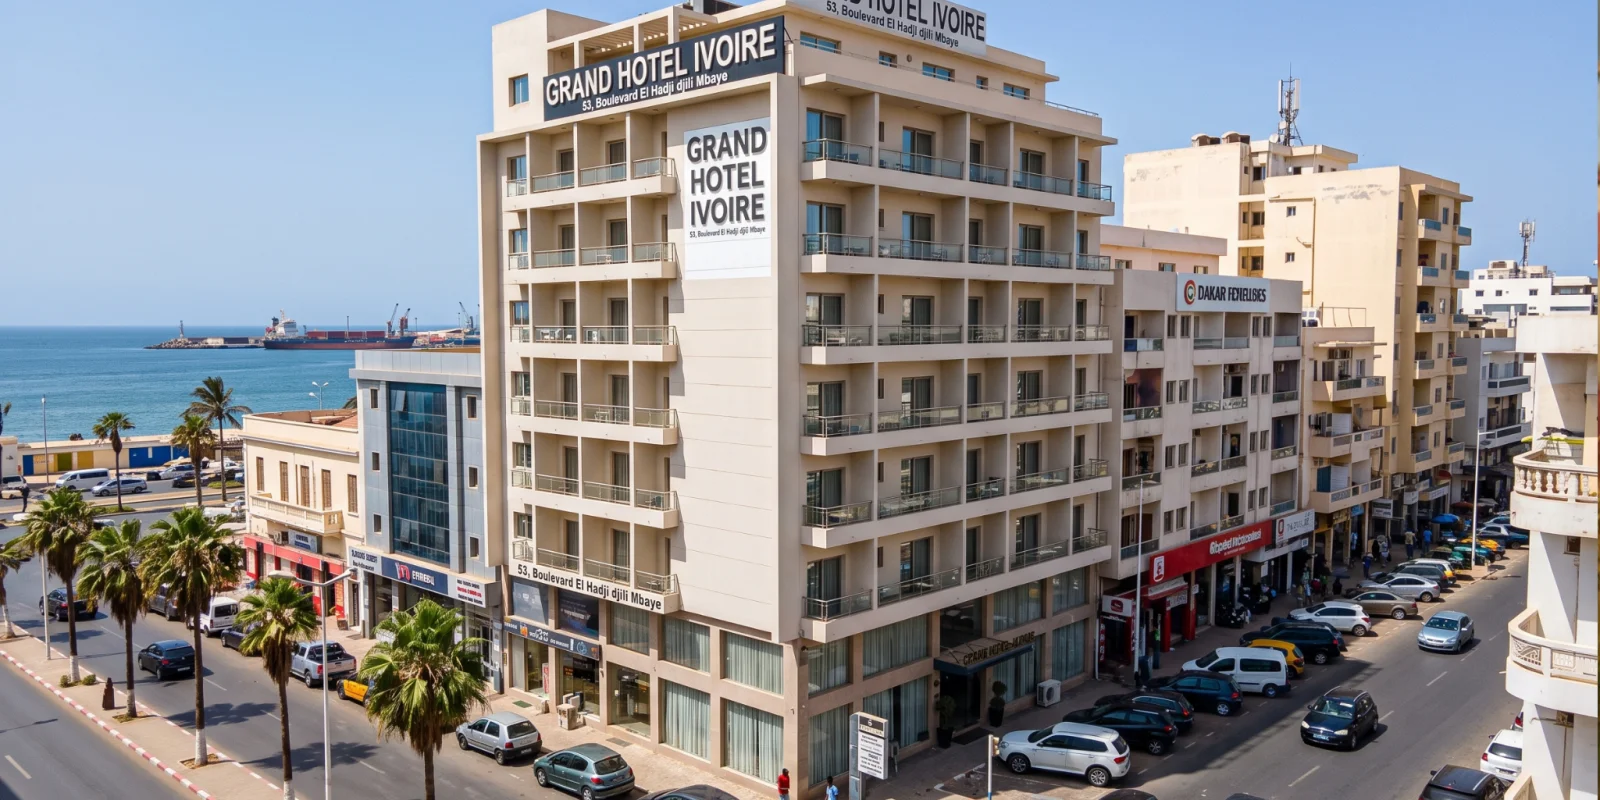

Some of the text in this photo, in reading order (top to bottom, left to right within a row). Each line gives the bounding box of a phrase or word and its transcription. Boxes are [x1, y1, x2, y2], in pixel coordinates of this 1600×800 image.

[826, 1, 839, 16] 53,
[842, 7, 885, 27] Boulevard
[887, 18, 895, 30] El
[919, 27, 934, 41] djili
[935, 32, 959, 48] Mbaye
[932, 1, 985, 42] IVOIRE
[546, 23, 777, 107] GRAND HOTEL IVOIRE
[582, 71, 728, 112] 53, Boulevard El Hadji djili Mbaye
[687, 126, 767, 163] GRAND
[691, 161, 764, 195] HOTEL
[691, 193, 765, 226] IVOIRE
[698, 229, 720, 237] Boulevard
[1198, 285, 1226, 301] DAKAR
[517, 564, 662, 610] 53, Boulevard El Hadji djili Mbaye
